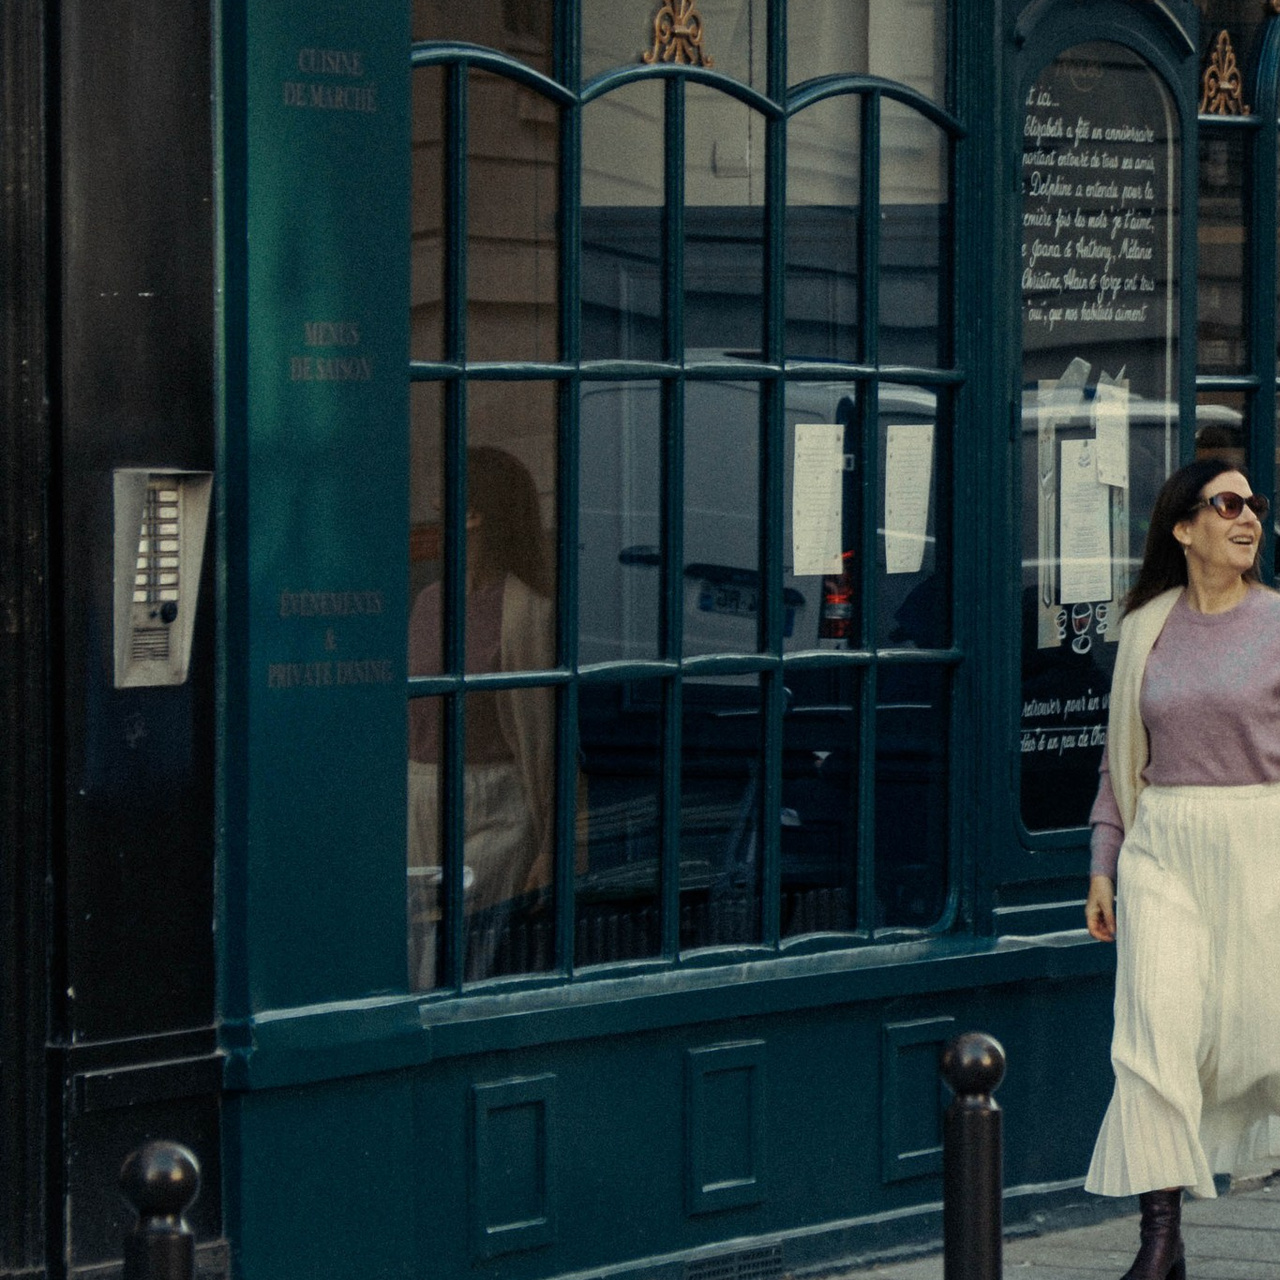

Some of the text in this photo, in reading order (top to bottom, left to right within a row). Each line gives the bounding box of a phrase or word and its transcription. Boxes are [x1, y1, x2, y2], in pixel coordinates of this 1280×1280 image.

[298, 47, 364, 77] CUISINE
[283, 81, 307, 107] DE
[1090, 151, 1100, 168] de
[1028, 170, 1072, 204] Delphine
[1075, 184, 1083, 197] a
[1121, 184, 1143, 209] pour
[1144, 180, 1155, 200] la
[1054, 208, 1071, 239] fois
[1073, 207, 1086, 228] les
